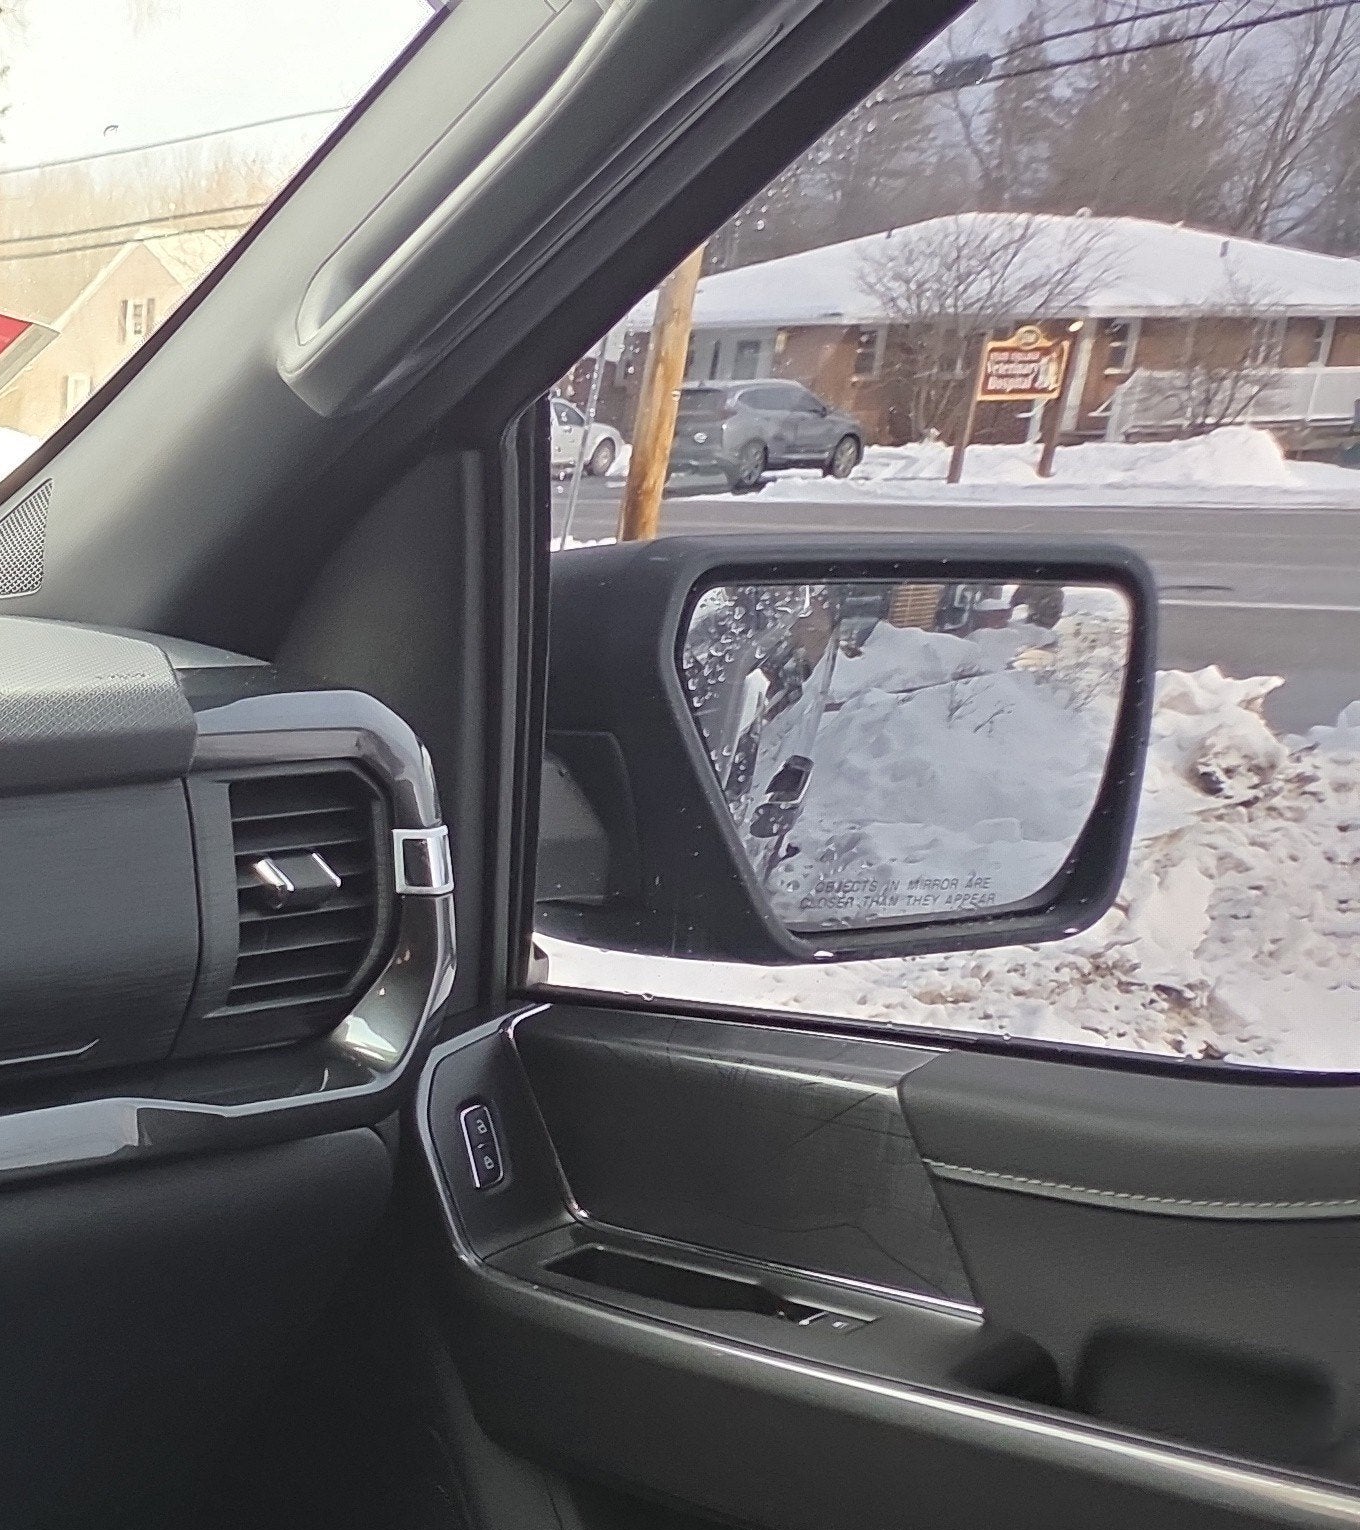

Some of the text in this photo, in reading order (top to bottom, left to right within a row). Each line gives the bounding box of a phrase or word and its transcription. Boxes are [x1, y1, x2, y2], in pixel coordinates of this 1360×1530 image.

[906, 877, 960, 890] MIRROR
[964, 876, 992, 889] ARE
[905, 893, 941, 907] THEY
